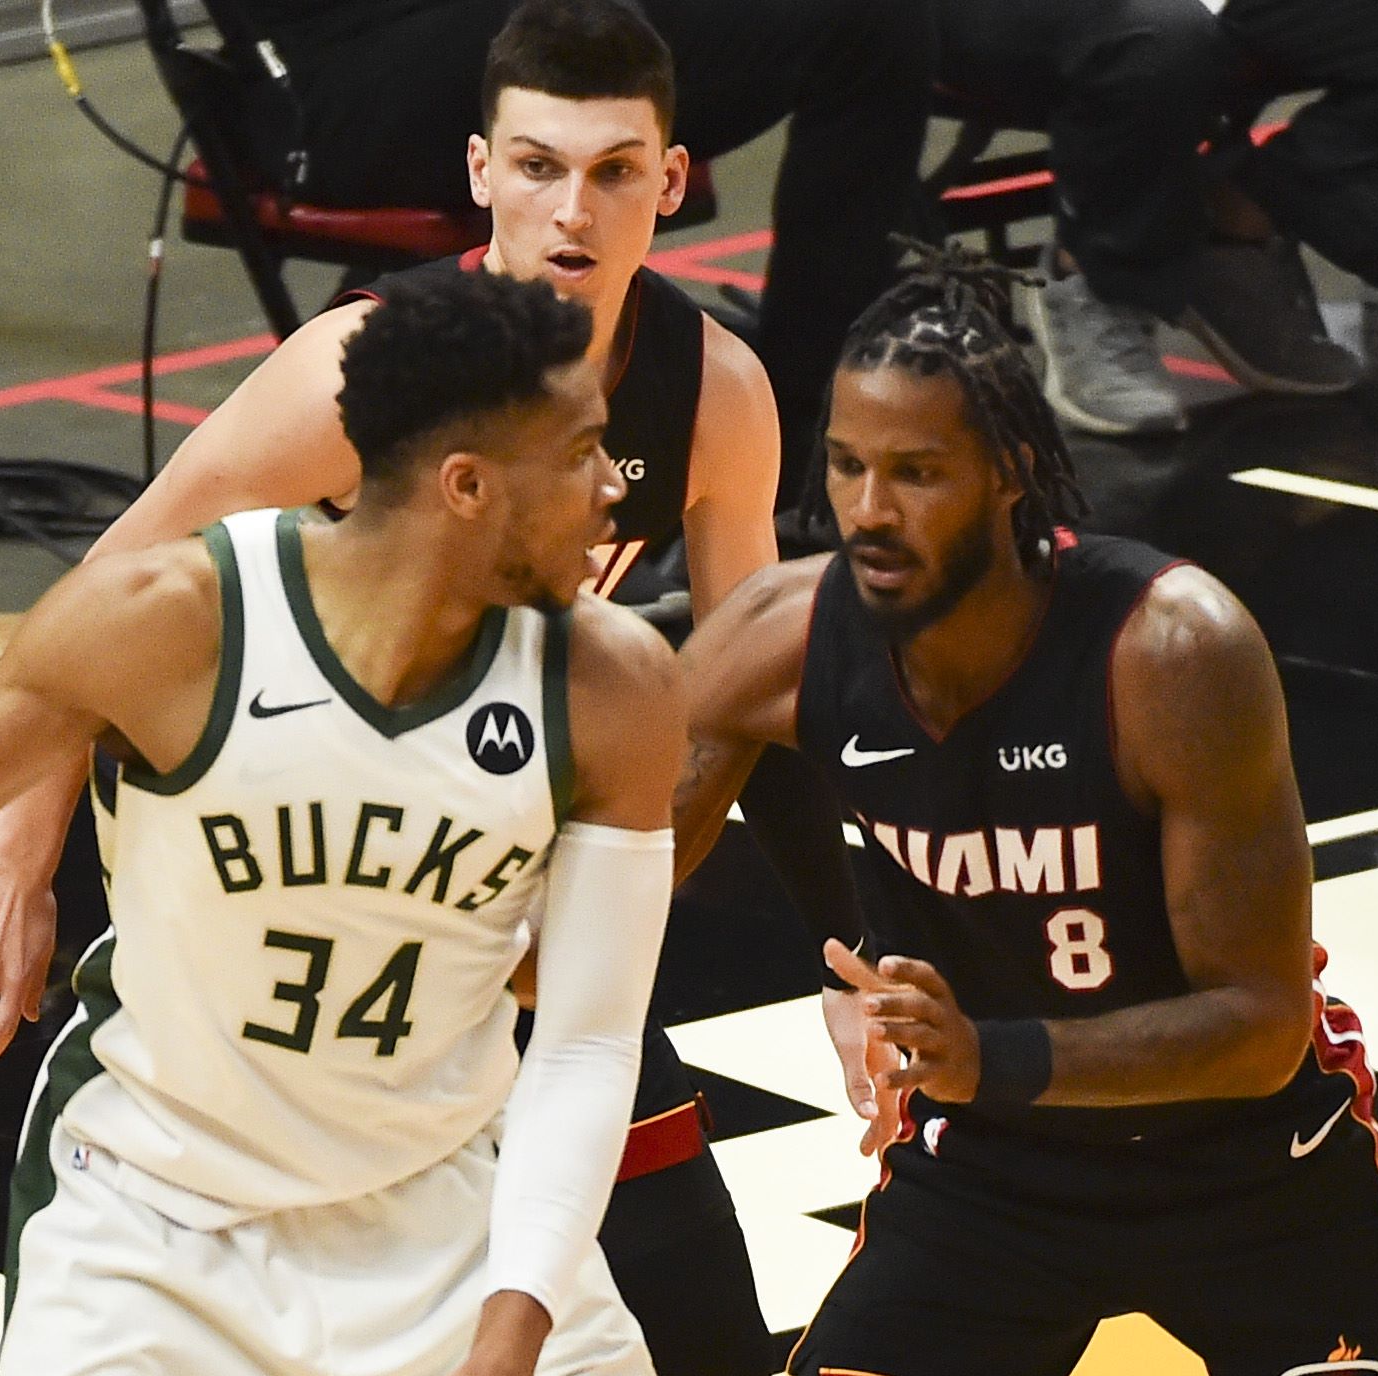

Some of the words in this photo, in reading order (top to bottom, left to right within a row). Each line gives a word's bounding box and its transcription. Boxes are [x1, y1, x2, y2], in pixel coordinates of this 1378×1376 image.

[609, 457, 646, 482] KG
[998, 743, 1068, 772] UKG
[200, 801, 536, 912] BUCKS
[242, 929, 424, 1057] 34
[1045, 905, 1114, 993] 8
